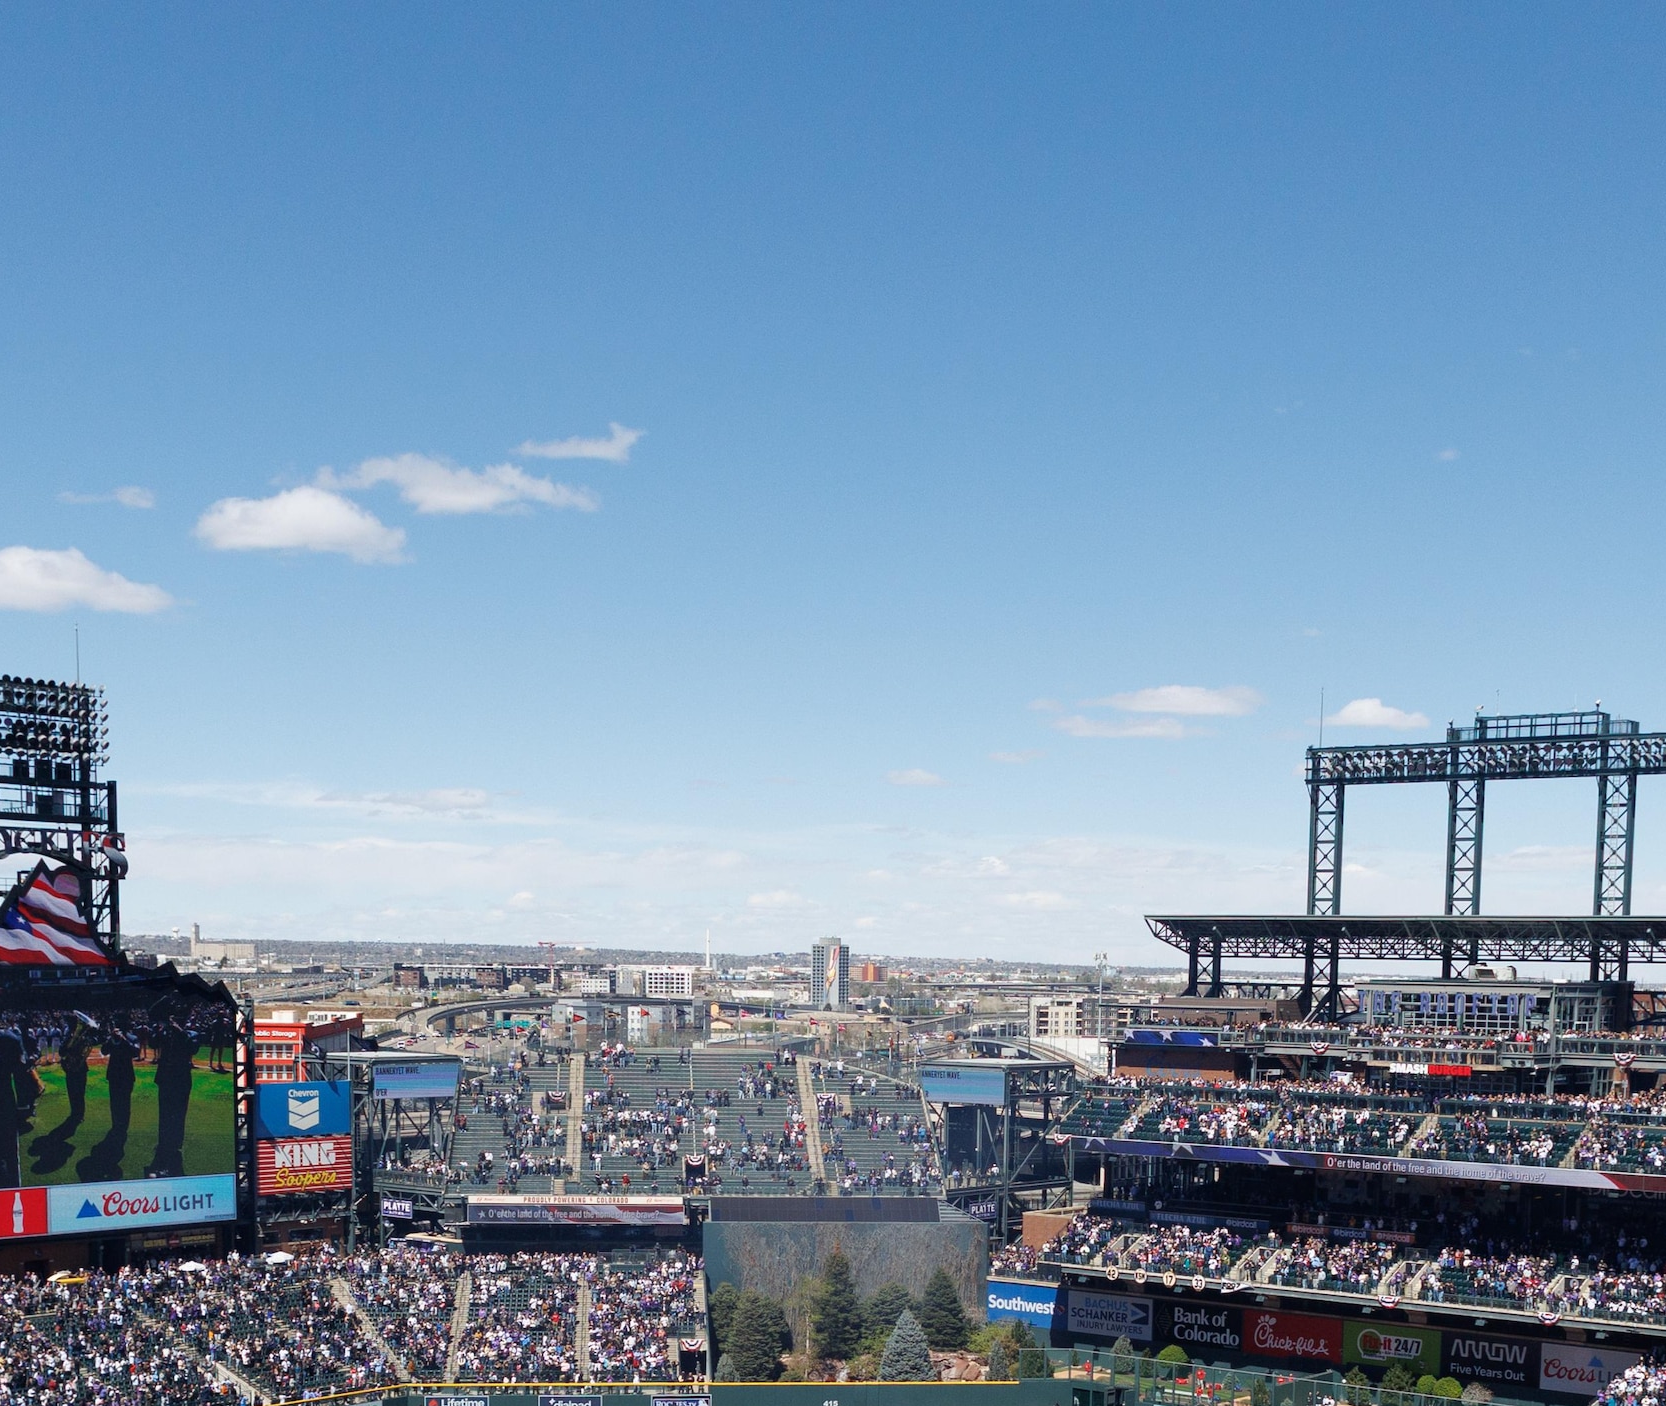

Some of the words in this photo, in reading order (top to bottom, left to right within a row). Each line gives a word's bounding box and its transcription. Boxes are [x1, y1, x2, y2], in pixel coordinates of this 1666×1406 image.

[1359, 990, 1402, 1013] THE
[1420, 992, 1536, 1016] ROOFTOP
[1390, 1063, 1472, 1076] SMASHBURGER
[288, 1088, 319, 1097] Chevron
[275, 1141, 335, 1168] KING
[1327, 1157, 1345, 1168] O'er
[1347, 1159, 1360, 1168] the
[1363, 1159, 1380, 1170] land
[1383, 1161, 1392, 1171] of
[1393, 1161, 1406, 1172] the
[1408, 1163, 1424, 1173] free
[1426, 1164, 1442, 1175] and
[1445, 1165, 1459, 1176] the
[1462, 1166, 1485, 1178] home
[1488, 1168, 1497, 1178] of
[1498, 1169, 1512, 1179] the
[1515, 1170, 1545, 1182] brave?
[275, 1168, 336, 1190] Soopers
[102, 1192, 160, 1217] Coors
[164, 1193, 213, 1211] LIGHT
[384, 1202, 410, 1211] PLATTE
[972, 1204, 995, 1214] PLATTE
[988, 1295, 1054, 1314] Southwest
[1085, 1297, 1128, 1311] BACHUS
[1071, 1308, 1127, 1322] SCHANKER
[1174, 1308, 1209, 1325] Bank
[1212, 1311, 1226, 1325] of
[1077, 1320, 1104, 1331] INJURY
[1106, 1322, 1142, 1334] LAWYERS
[1174, 1325, 1239, 1346] Colorado
[1395, 1339, 1421, 1354] 24/7
[1452, 1339, 1526, 1364] ARROW
[1450, 1363, 1472, 1376] Five
[1475, 1366, 1502, 1381] Years
[1505, 1369, 1525, 1381] Out
[1544, 1358, 1596, 1383] Coors
